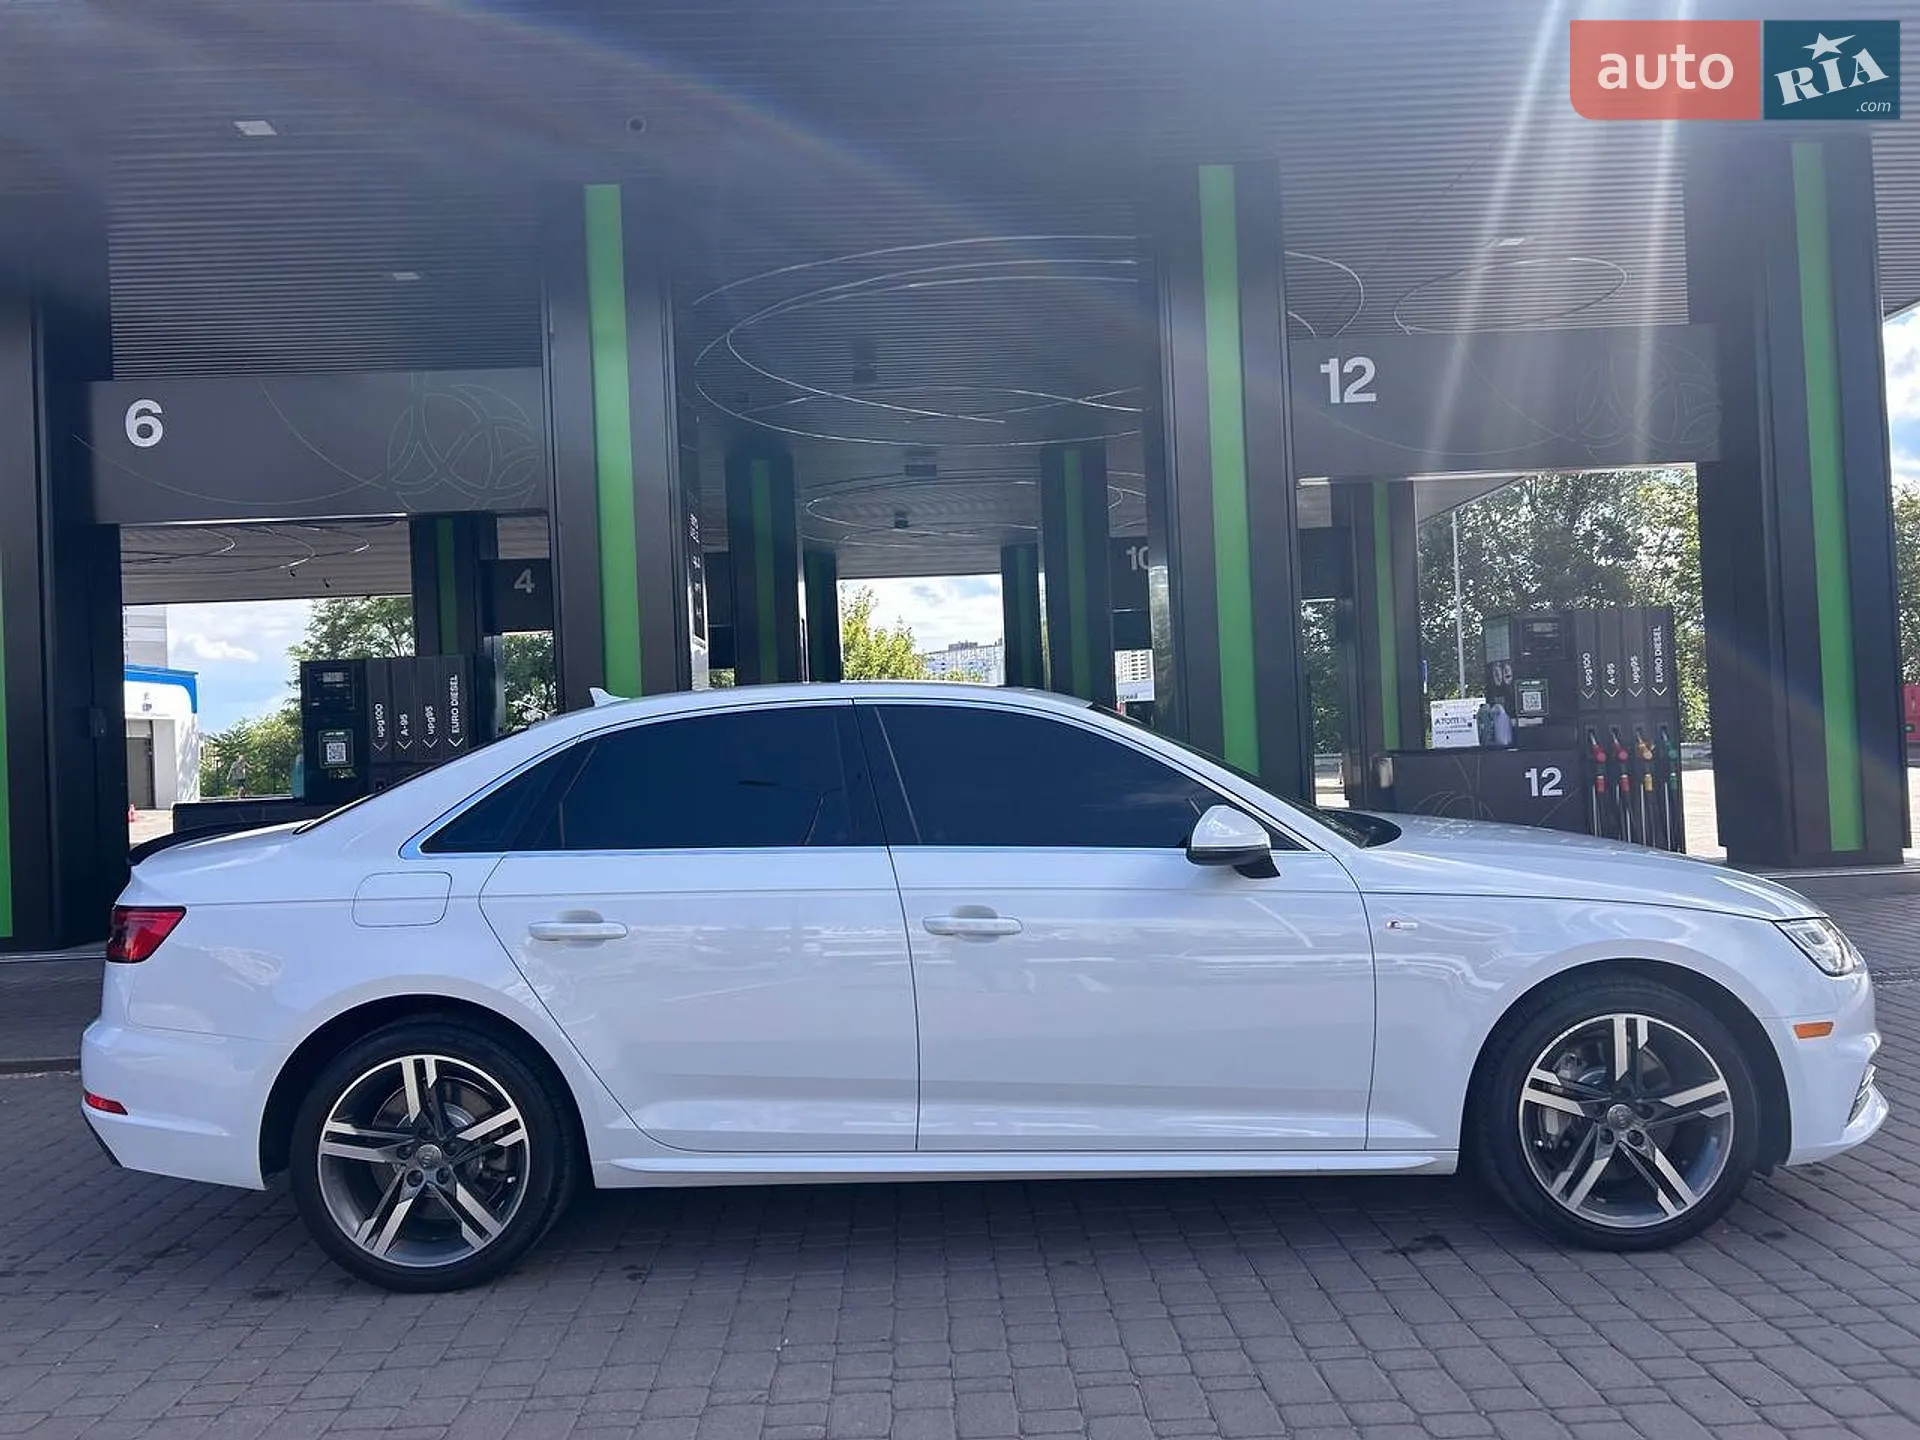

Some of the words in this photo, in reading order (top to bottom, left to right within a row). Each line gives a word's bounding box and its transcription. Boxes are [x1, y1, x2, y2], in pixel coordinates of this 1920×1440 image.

[1320, 356, 1377, 403] 12
[125, 399, 163, 447] 6
[513, 568, 535, 594] 4
[1652, 625, 1662, 656] DIESEL
[1654, 658, 1664, 683] EURO
[449, 674, 459, 706] DIESEL
[399, 713, 409, 736] A-95
[450, 707, 460, 733] EURO
[1524, 767, 1563, 796] 12
